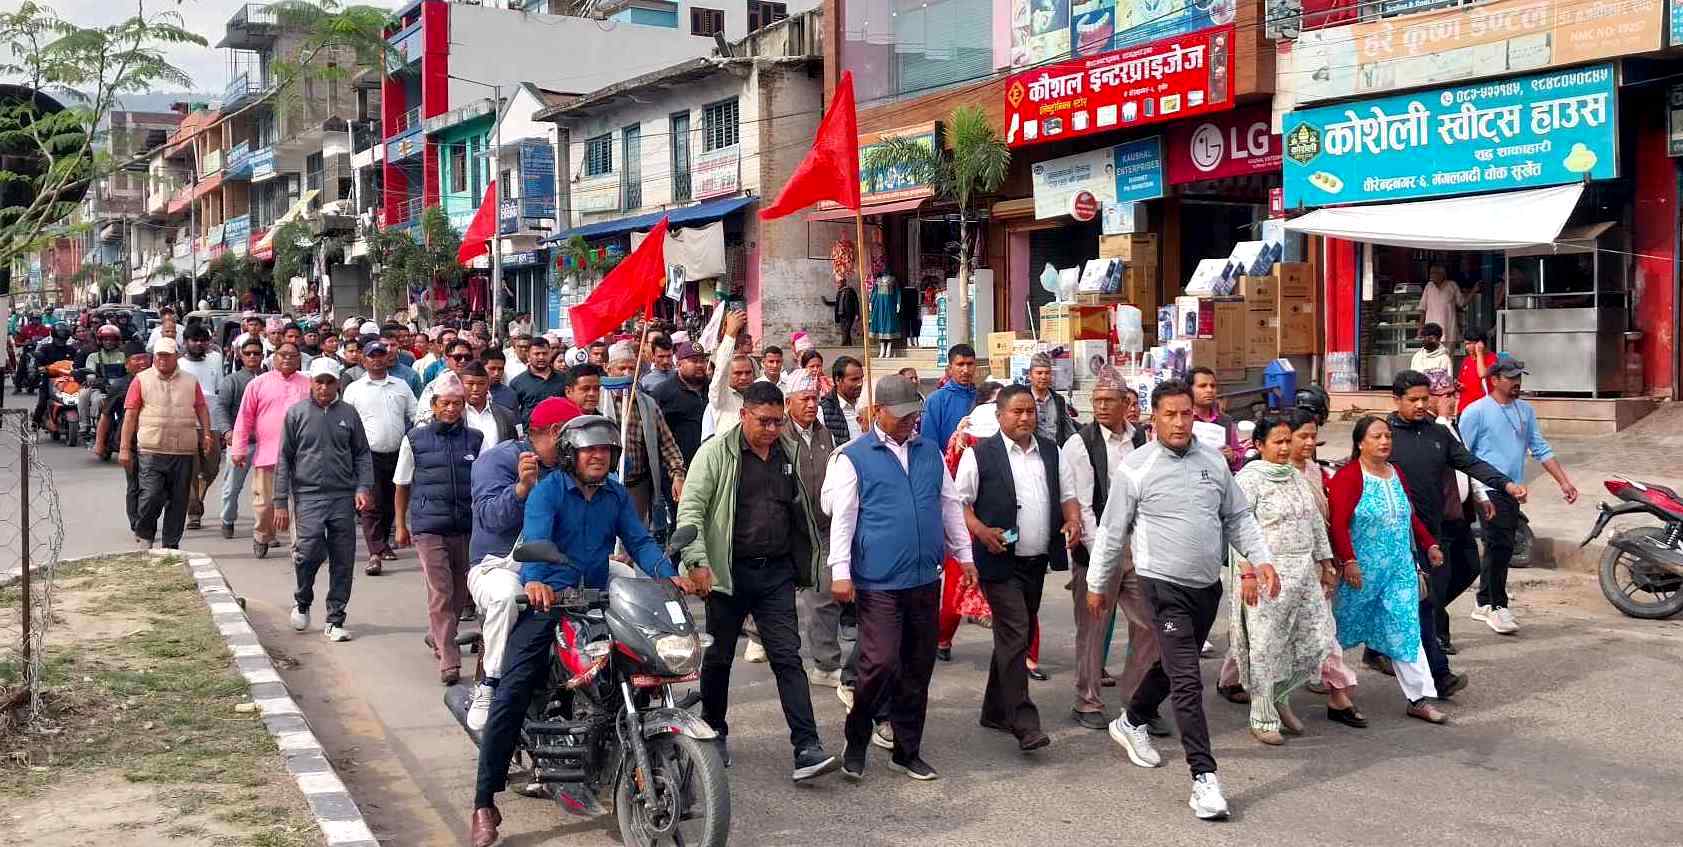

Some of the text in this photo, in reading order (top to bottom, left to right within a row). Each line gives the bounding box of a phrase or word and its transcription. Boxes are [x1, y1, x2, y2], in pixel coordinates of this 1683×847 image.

[1028, 72, 1084, 102] कौशल
[1088, 43, 1206, 92] इन्टरप्राइजेज
[1230, 122, 1269, 159] LG
[1324, 92, 1608, 155] कोशेली स्वीट्स हाउस
[1116, 160, 1161, 176] ENTERPRISES
